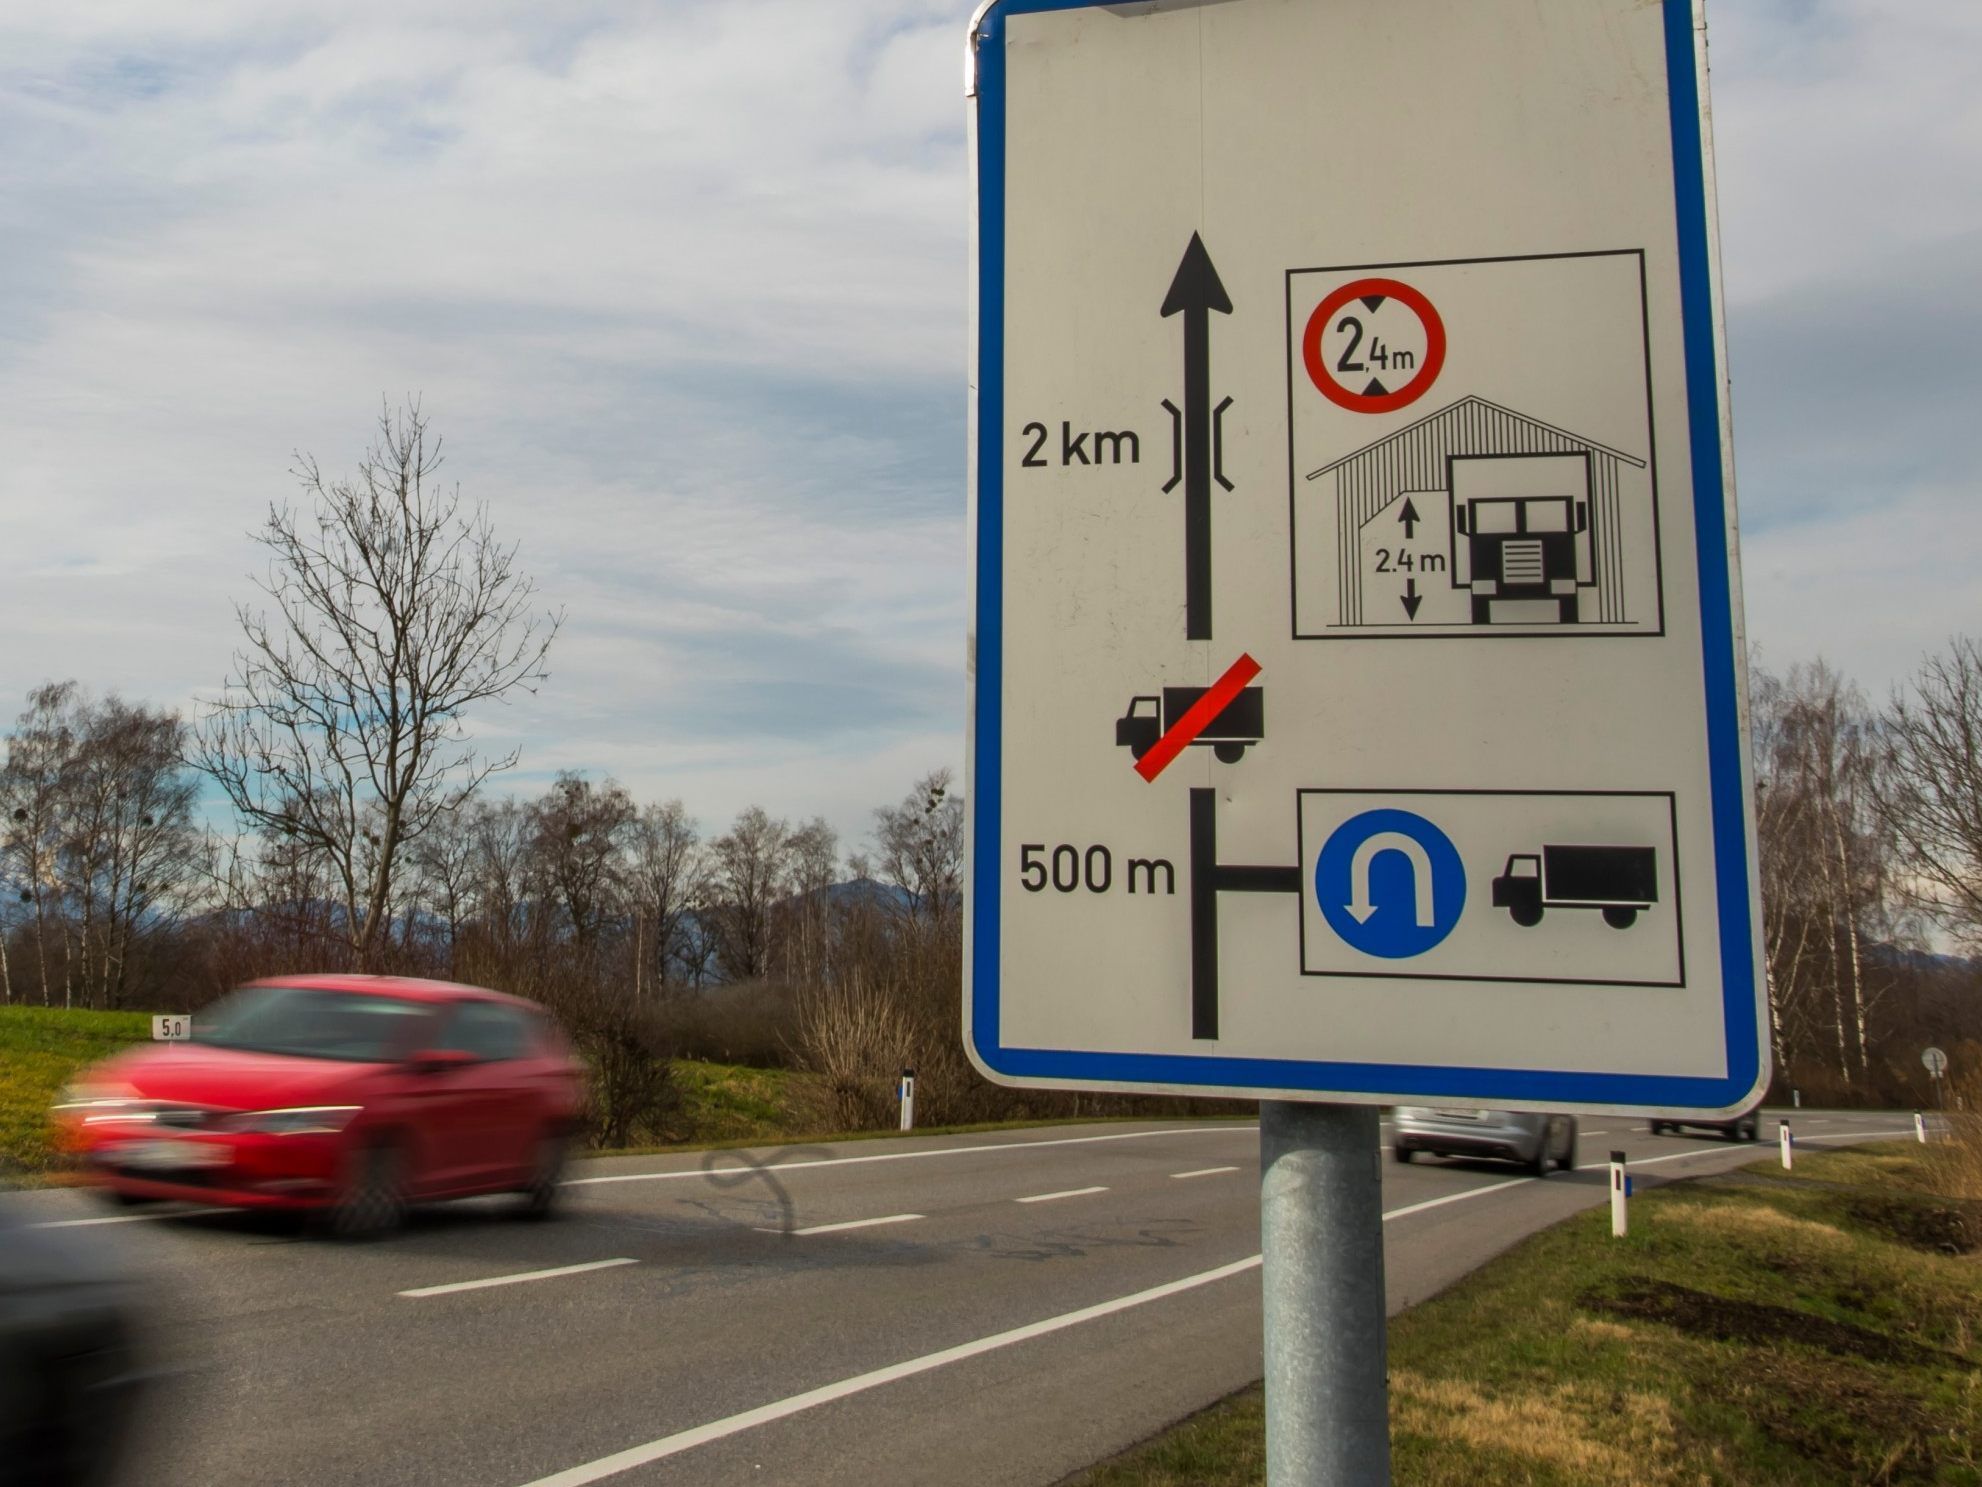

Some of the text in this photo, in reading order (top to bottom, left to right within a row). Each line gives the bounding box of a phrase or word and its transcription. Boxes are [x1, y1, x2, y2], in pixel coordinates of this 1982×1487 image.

[1021, 421, 1140, 467] 2 km
[1021, 844, 1175, 894] 500 m
